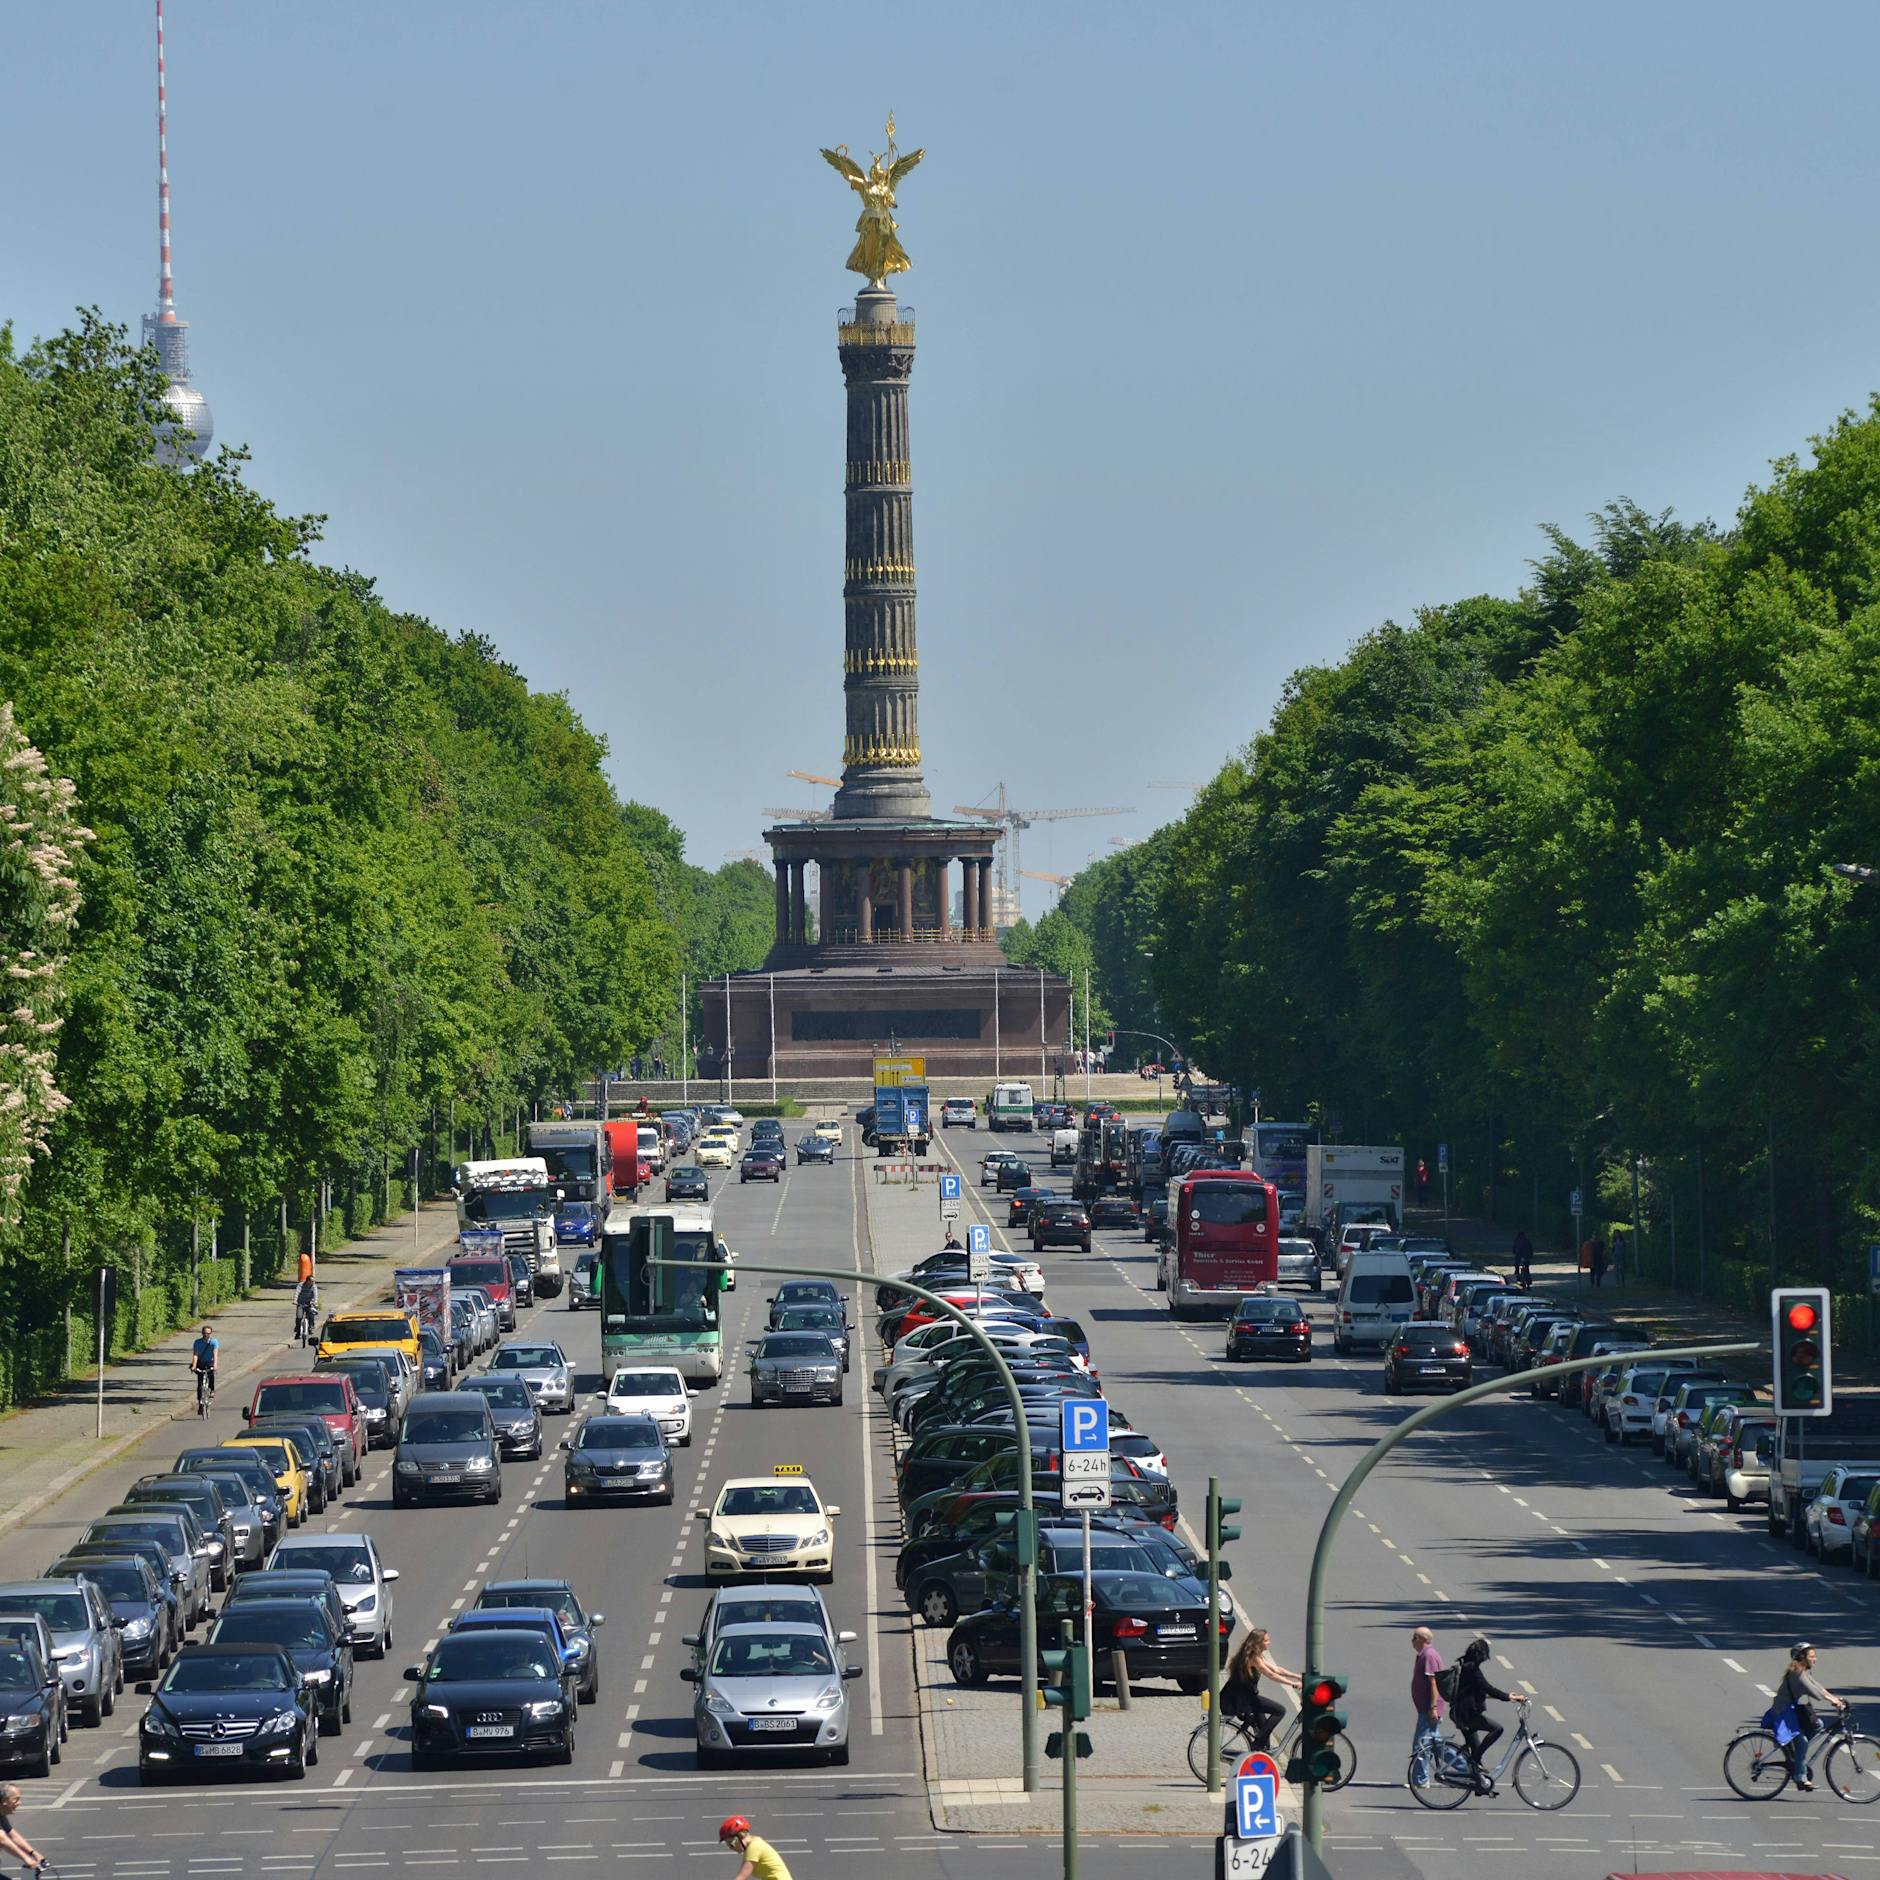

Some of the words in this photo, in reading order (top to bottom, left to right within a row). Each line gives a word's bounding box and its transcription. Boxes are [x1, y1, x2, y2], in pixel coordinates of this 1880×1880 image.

[945, 1178, 957, 1196] P
[974, 1228, 985, 1250] P
[1073, 1406, 1098, 1445] P
[1068, 1458, 1106, 1472] 6-24h
[1243, 1784, 1263, 1829] P
[1231, 1848, 1277, 1870] 6-24
